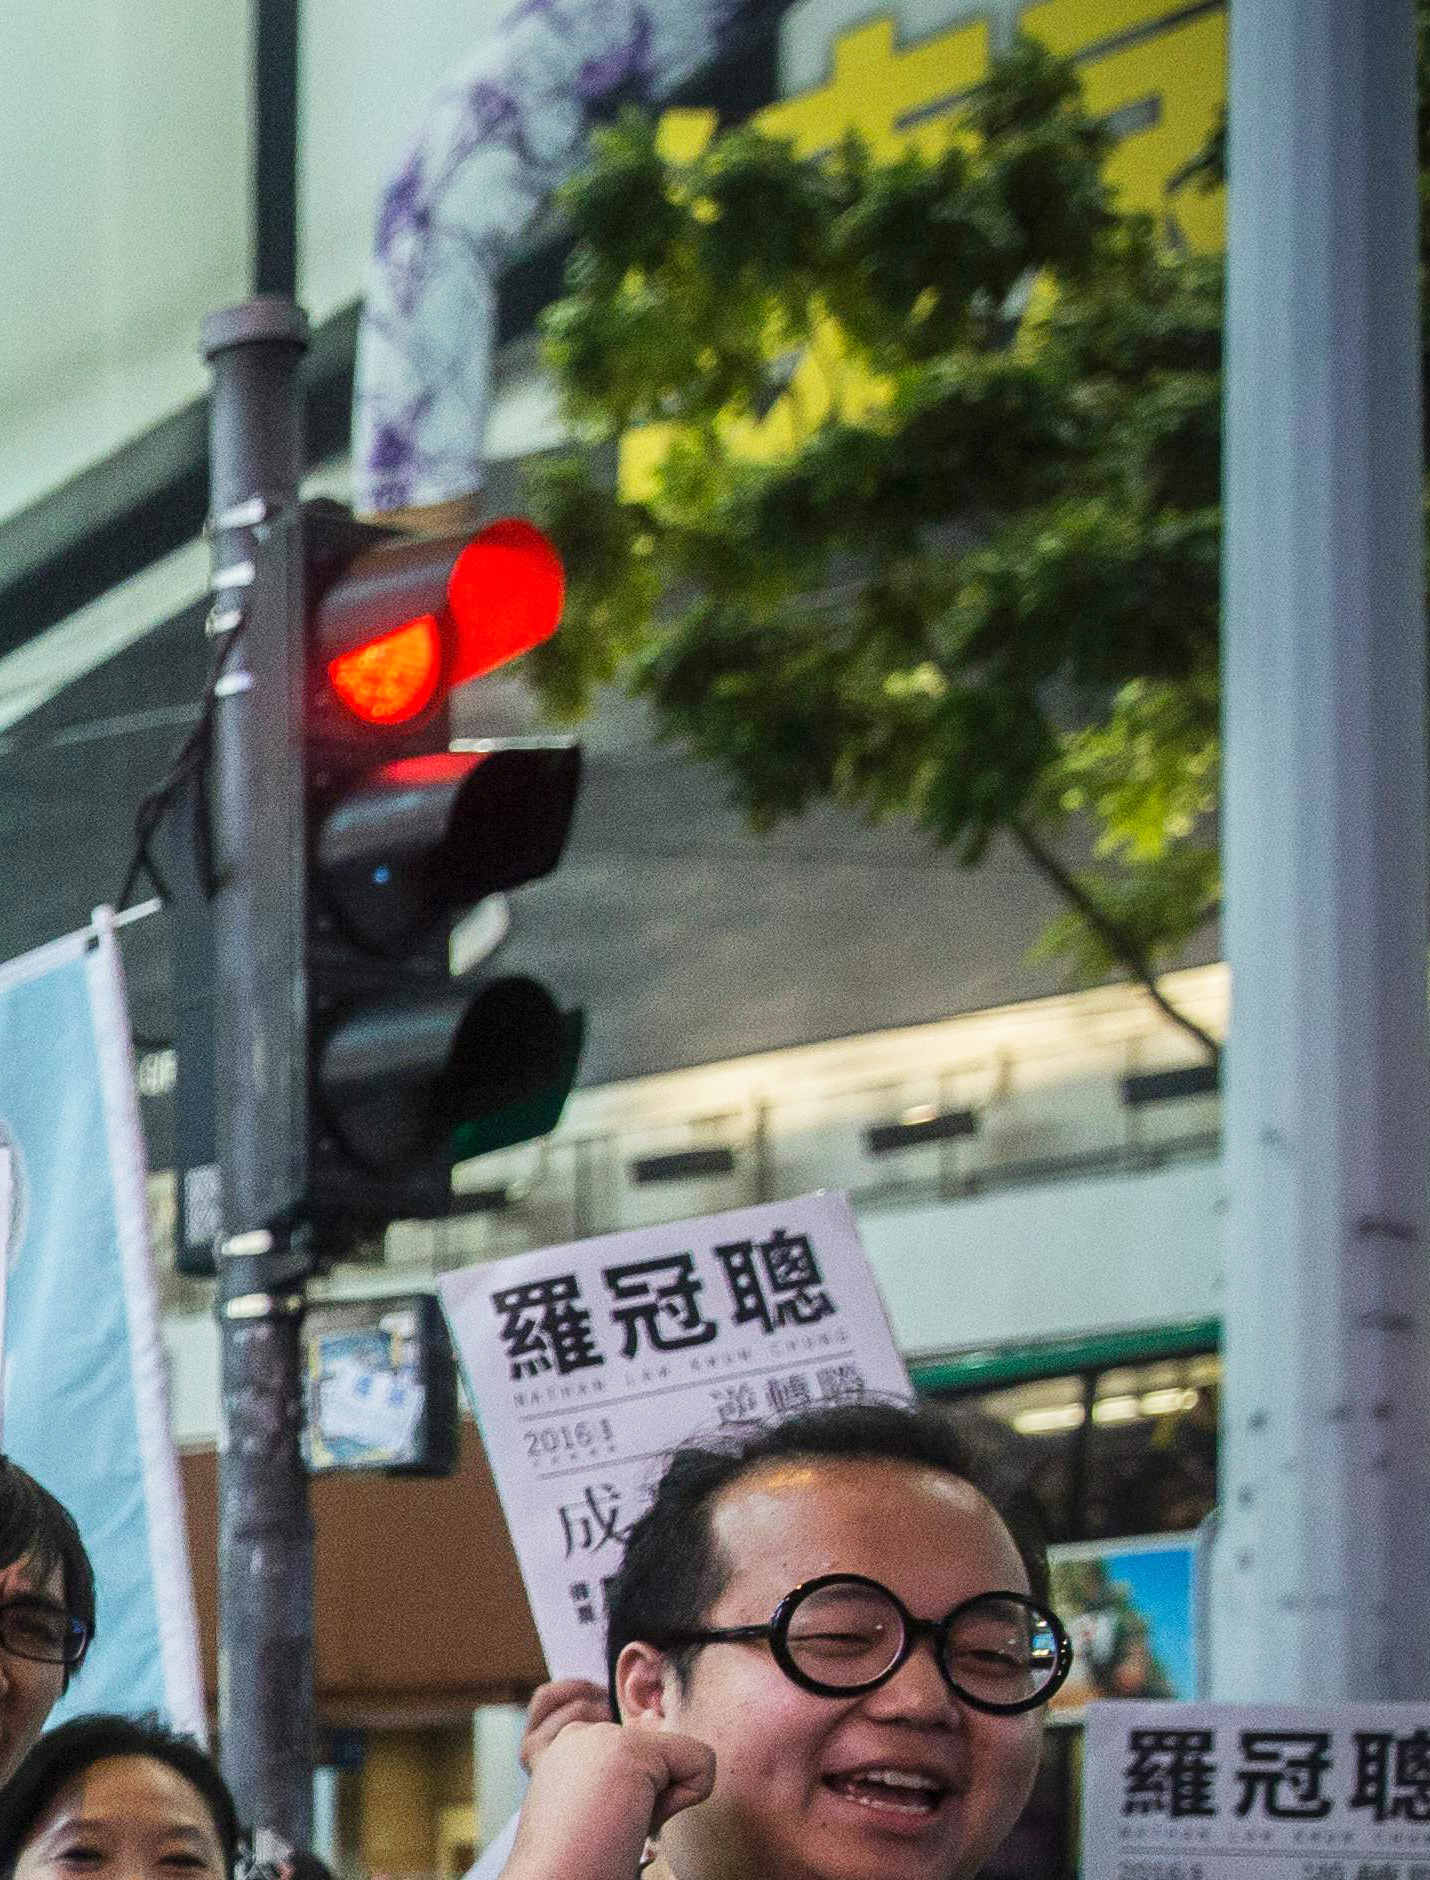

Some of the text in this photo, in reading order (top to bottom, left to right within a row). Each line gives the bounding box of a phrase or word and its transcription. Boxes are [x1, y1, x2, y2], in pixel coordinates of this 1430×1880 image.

[491, 1229, 838, 1382] 羅冠聰
[523, 1421, 592, 1457] 2016
